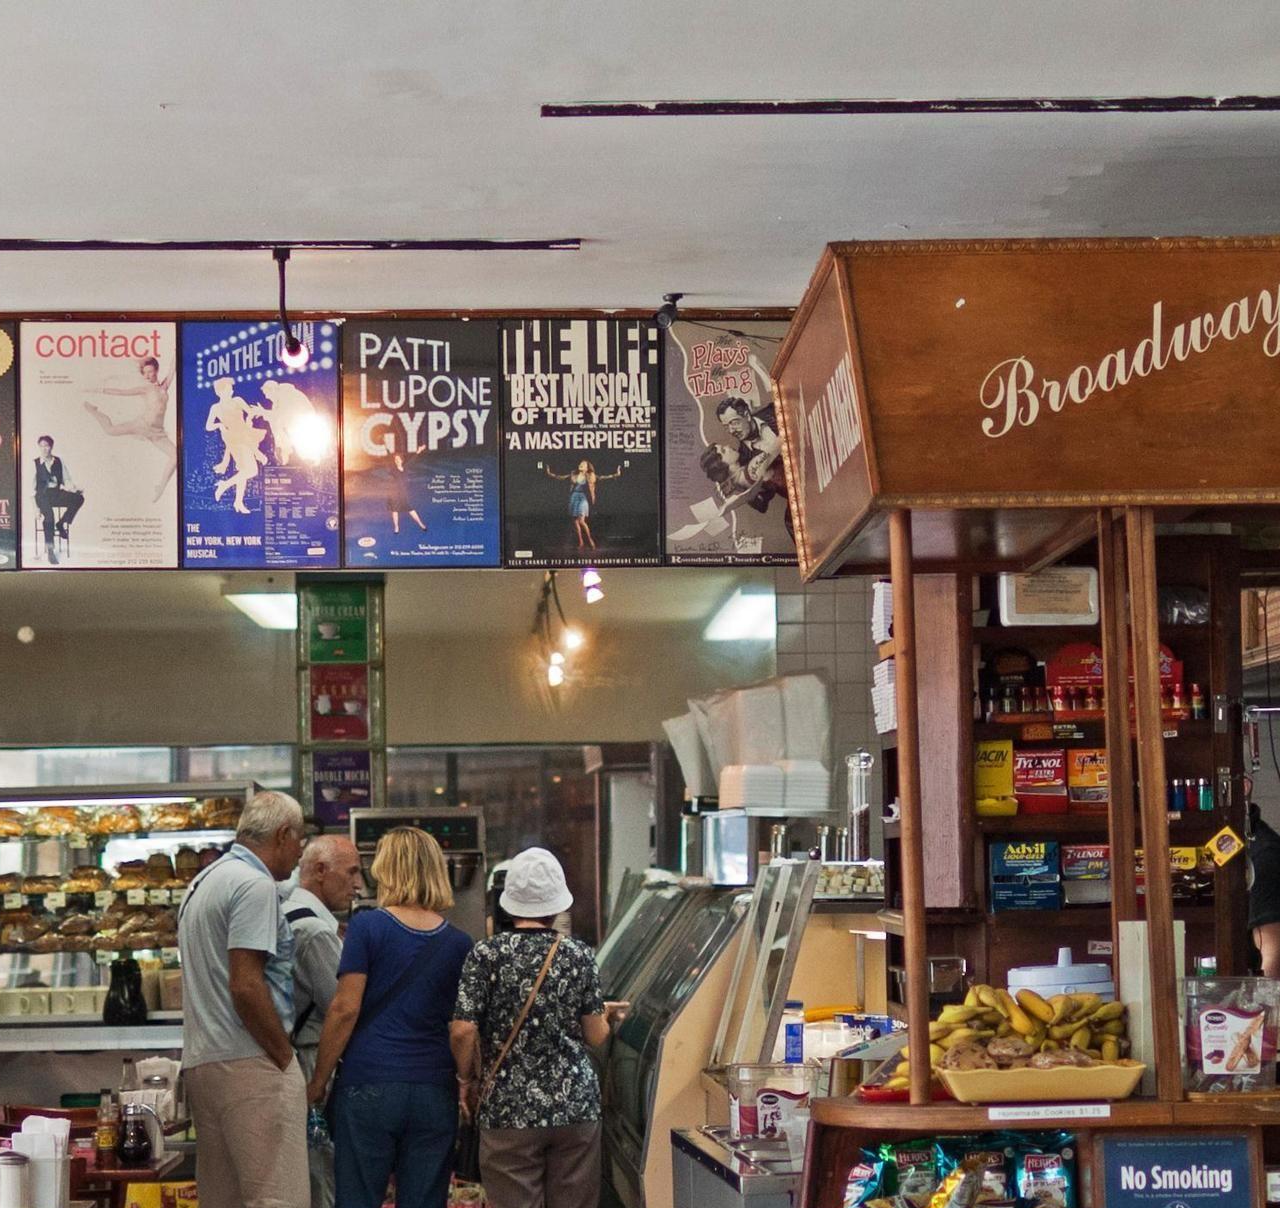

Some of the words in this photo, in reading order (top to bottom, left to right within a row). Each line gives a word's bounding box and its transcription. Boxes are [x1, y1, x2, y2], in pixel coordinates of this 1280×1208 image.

[36, 330, 161, 359] contact
[359, 332, 451, 372] PATTI
[207, 354, 231, 378] ON
[233, 344, 263, 372] THE
[688, 368, 754, 398] Thing
[562, 373, 651, 408] MUSICAL
[511, 408, 539, 425] OF
[540, 408, 583, 425] THE
[362, 408, 491, 457] GYPSY
[186, 523, 201, 533] THE
[186, 536, 202, 547] NEW
[203, 536, 224, 547] YORK,
[225, 536, 241, 547] NEW
[242, 536, 262, 546] YORK
[186, 549, 218, 559] MUSICAL
[672, 555, 723, 564] Roundabout
[725, 555, 760, 564] Theatre
[761, 555, 799, 565] Compa
[336, 605, 366, 617] CREAM
[314, 770, 343, 782] DOUBLE
[344, 770, 369, 783] MOCHA
[1004, 843, 1045, 854] Advil
[1087, 861, 1104, 869] PM
[1045, 1108, 1076, 1117] Cookies
[1121, 1166, 1147, 1190] No
[1151, 1164, 1233, 1192] Smoking
[178, 1189, 197, 1199] Lipt
